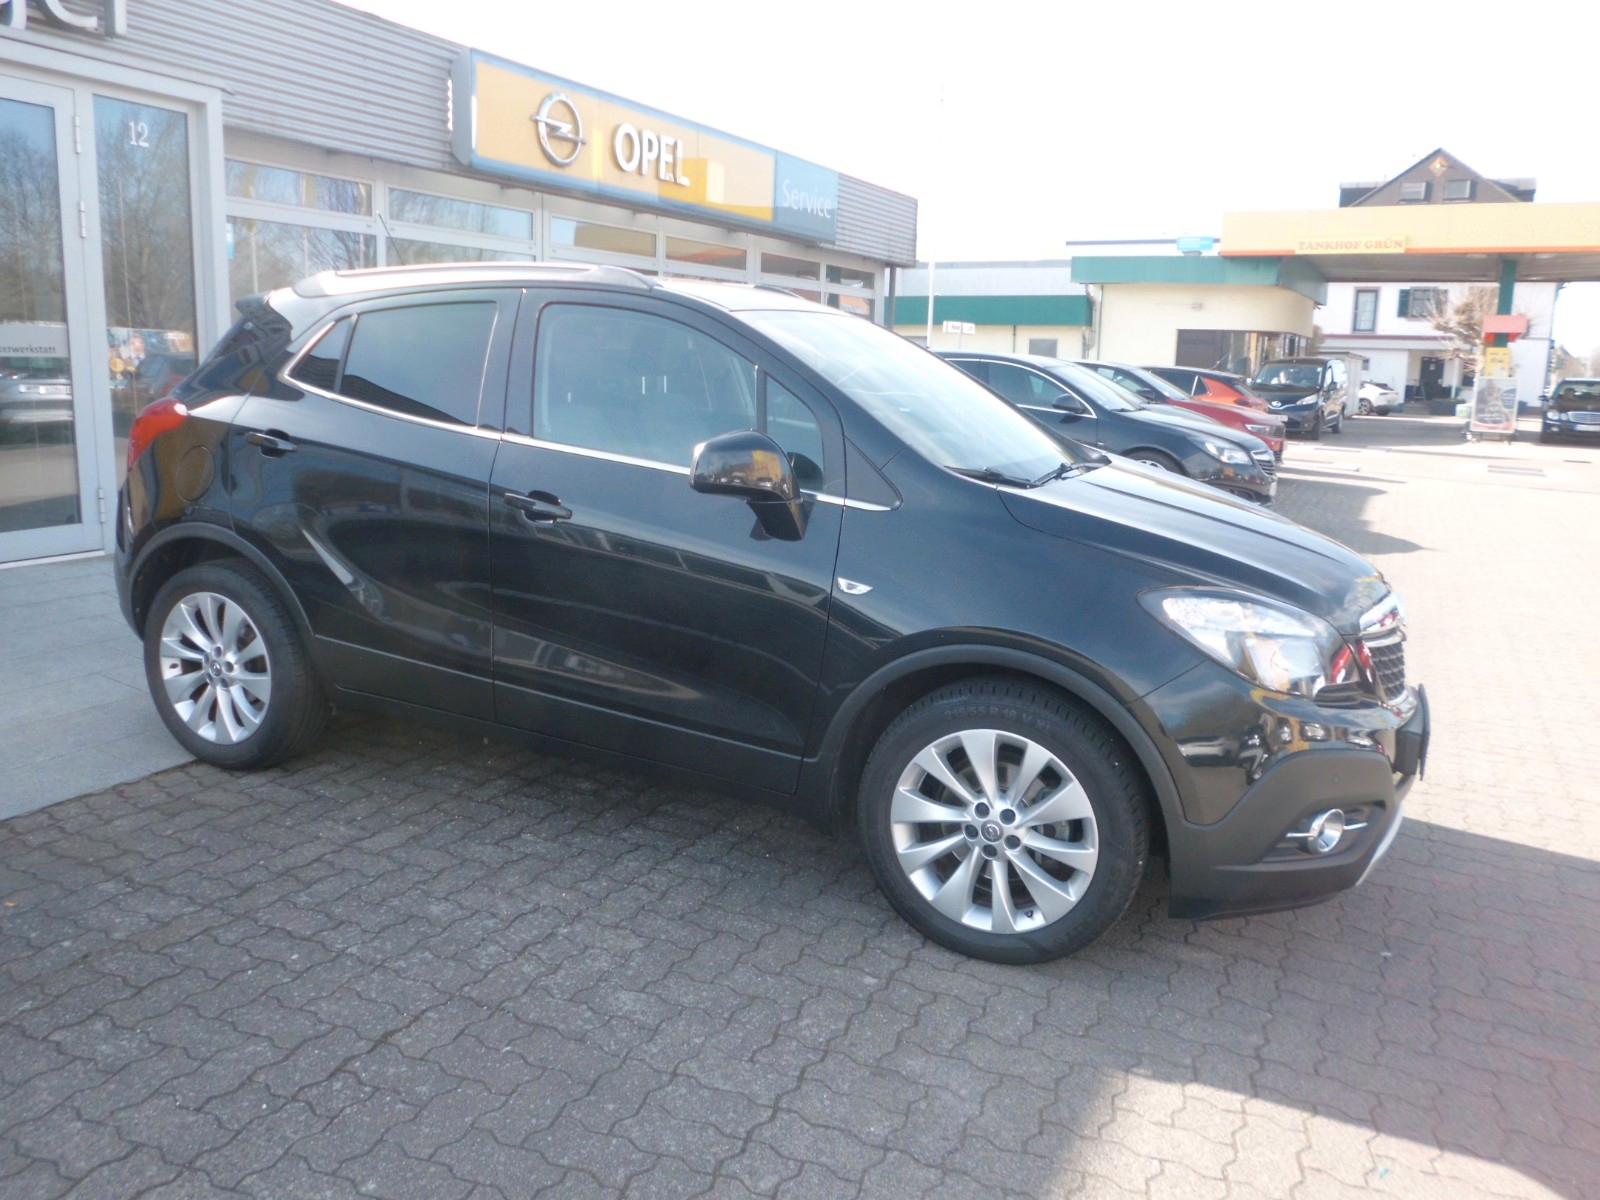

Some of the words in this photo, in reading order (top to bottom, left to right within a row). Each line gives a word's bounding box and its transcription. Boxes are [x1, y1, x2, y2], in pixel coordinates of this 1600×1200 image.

[128, 121, 150, 147] 12
[612, 122, 691, 187] OPEL
[782, 178, 832, 218] Service
[1297, 240, 1361, 250] TANKHOF
